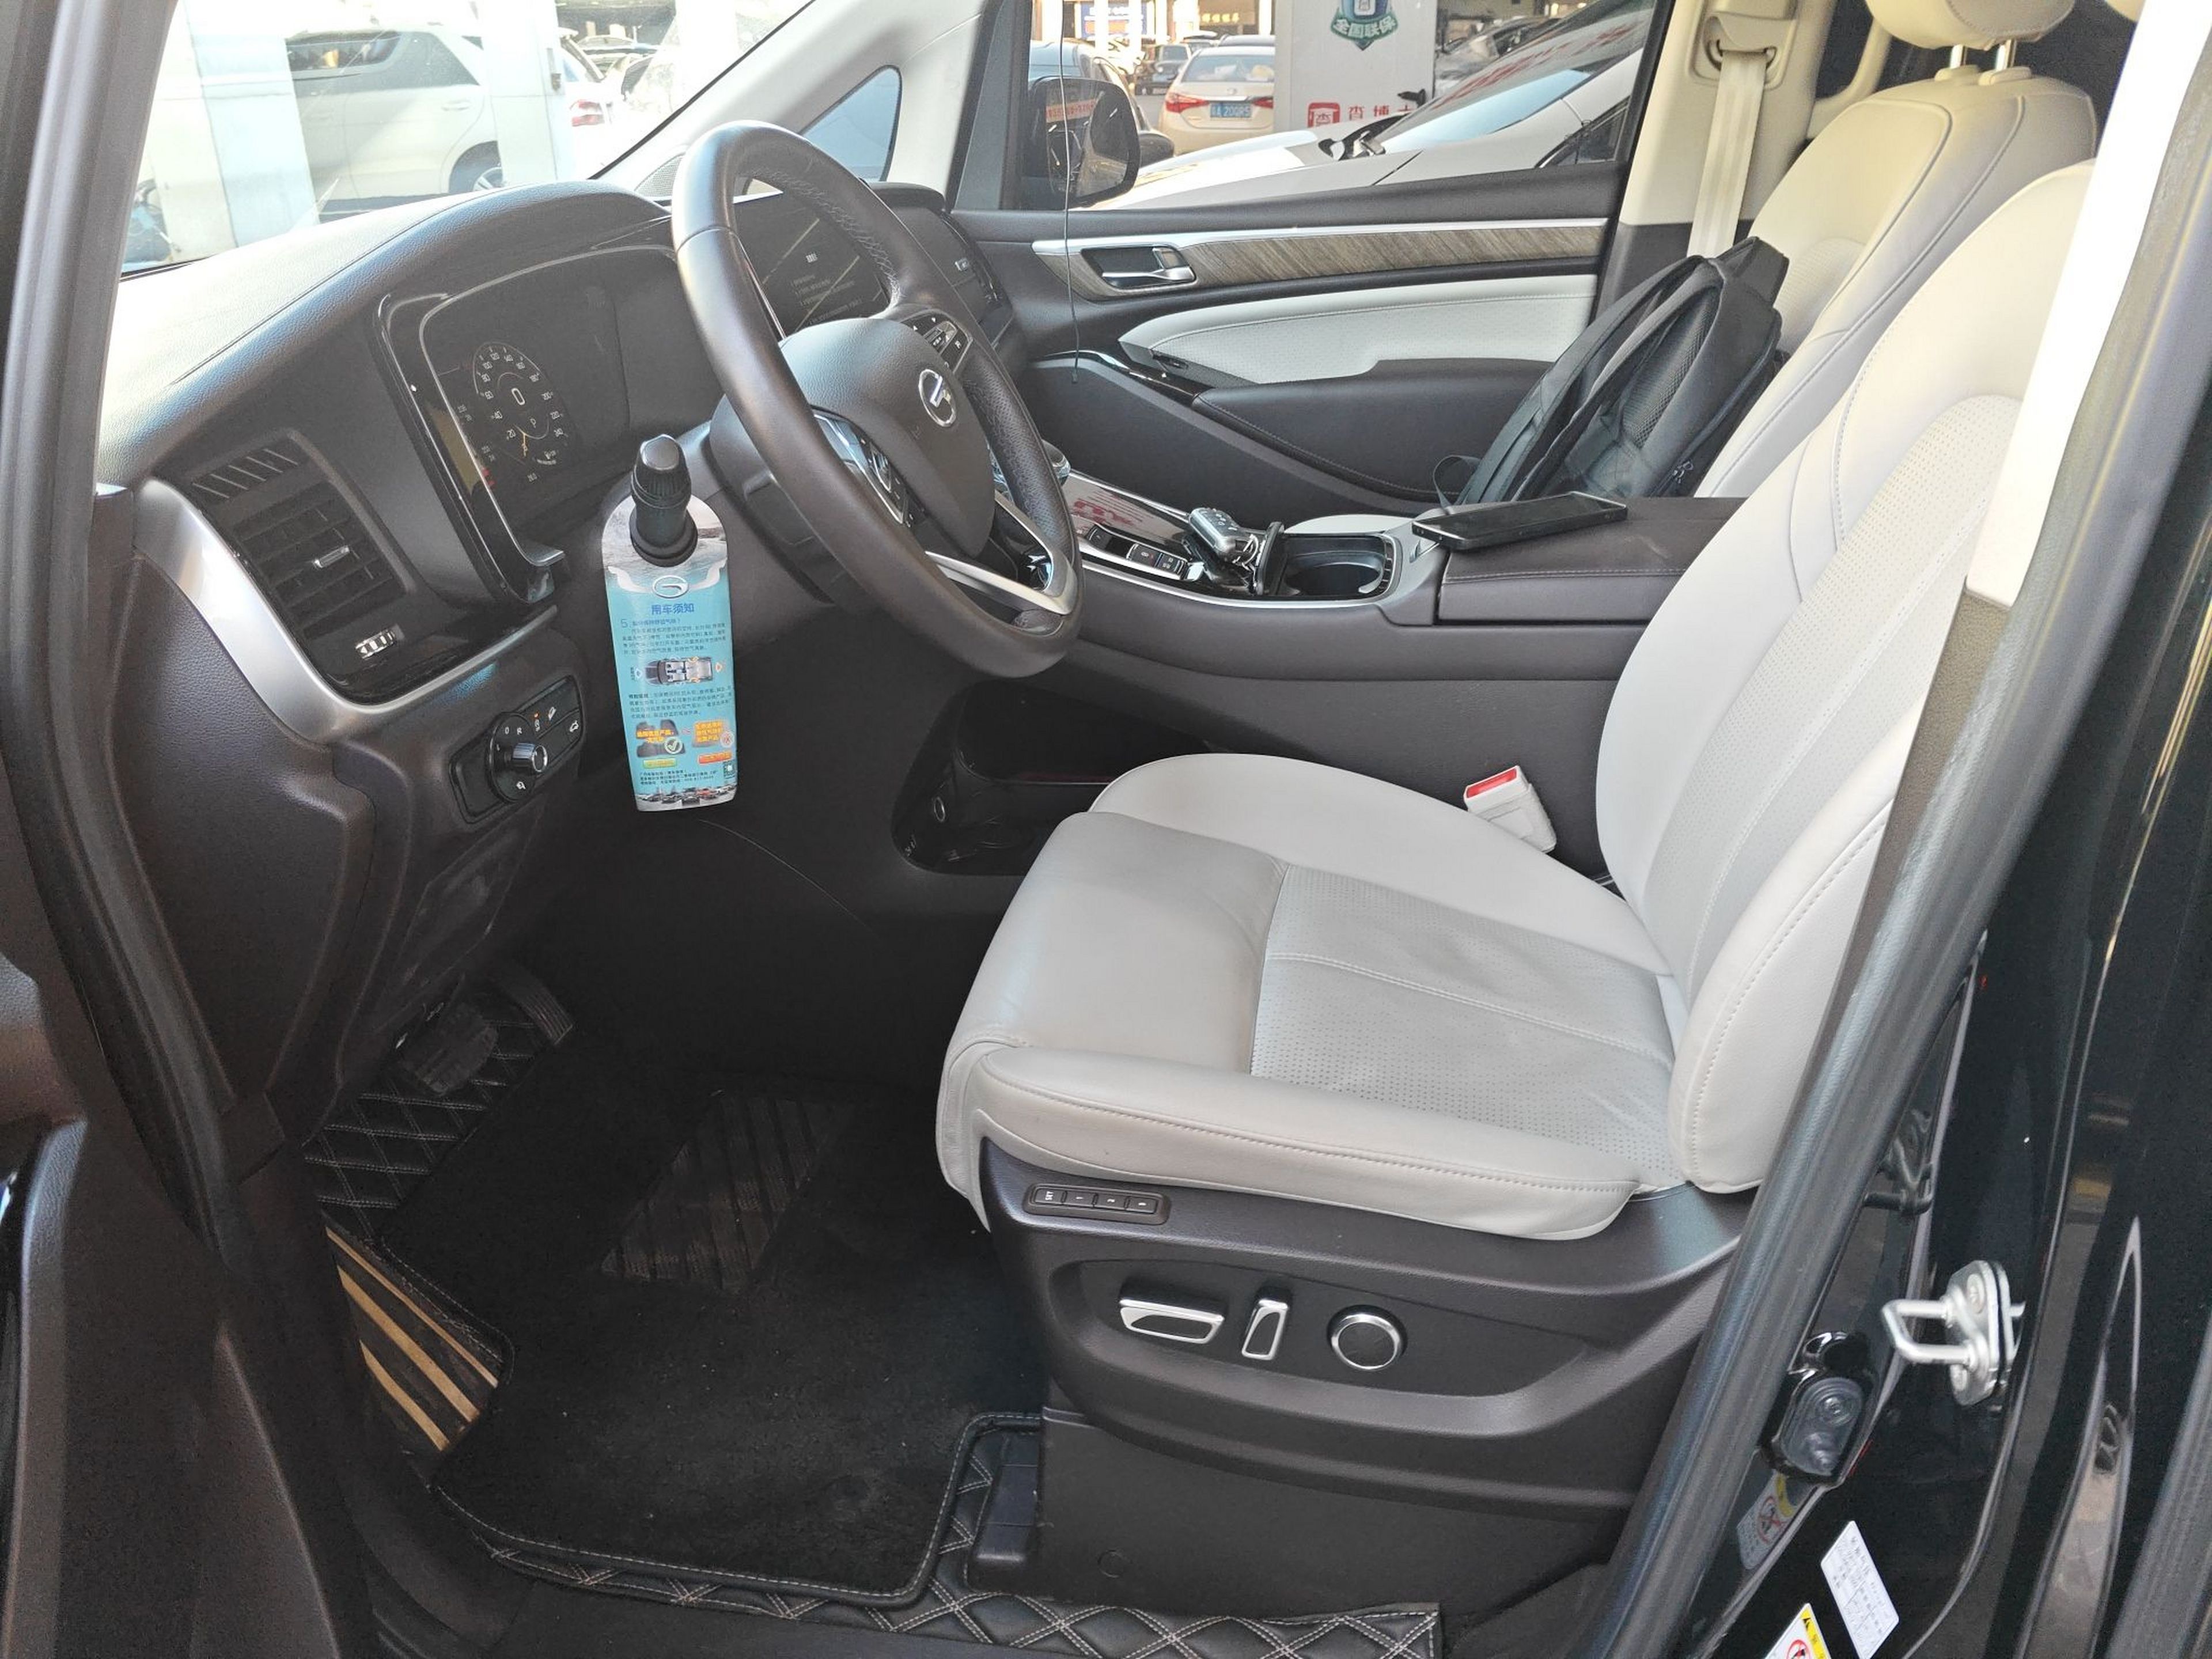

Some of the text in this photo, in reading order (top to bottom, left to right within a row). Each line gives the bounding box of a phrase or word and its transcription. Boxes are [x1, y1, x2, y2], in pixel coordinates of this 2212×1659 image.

[1332, 16, 1396, 39] 全国联保
[652, 603, 695, 615] 用车须知
